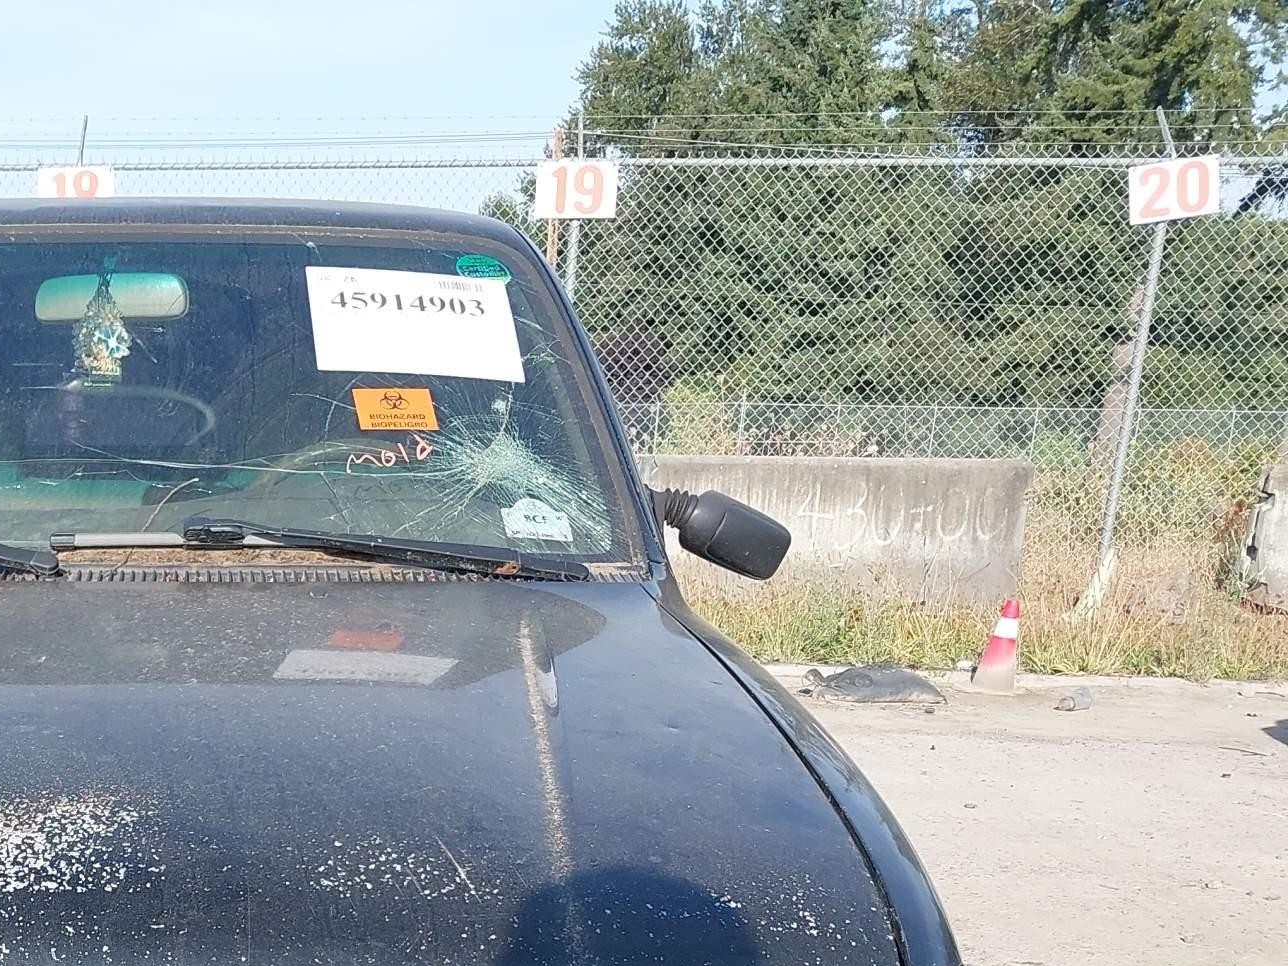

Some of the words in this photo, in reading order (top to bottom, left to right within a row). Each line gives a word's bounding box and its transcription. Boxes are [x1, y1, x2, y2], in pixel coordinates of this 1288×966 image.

[551, 164, 604, 214] 19
[1139, 160, 1210, 218] 20
[330, 290, 486, 317] 45914903
